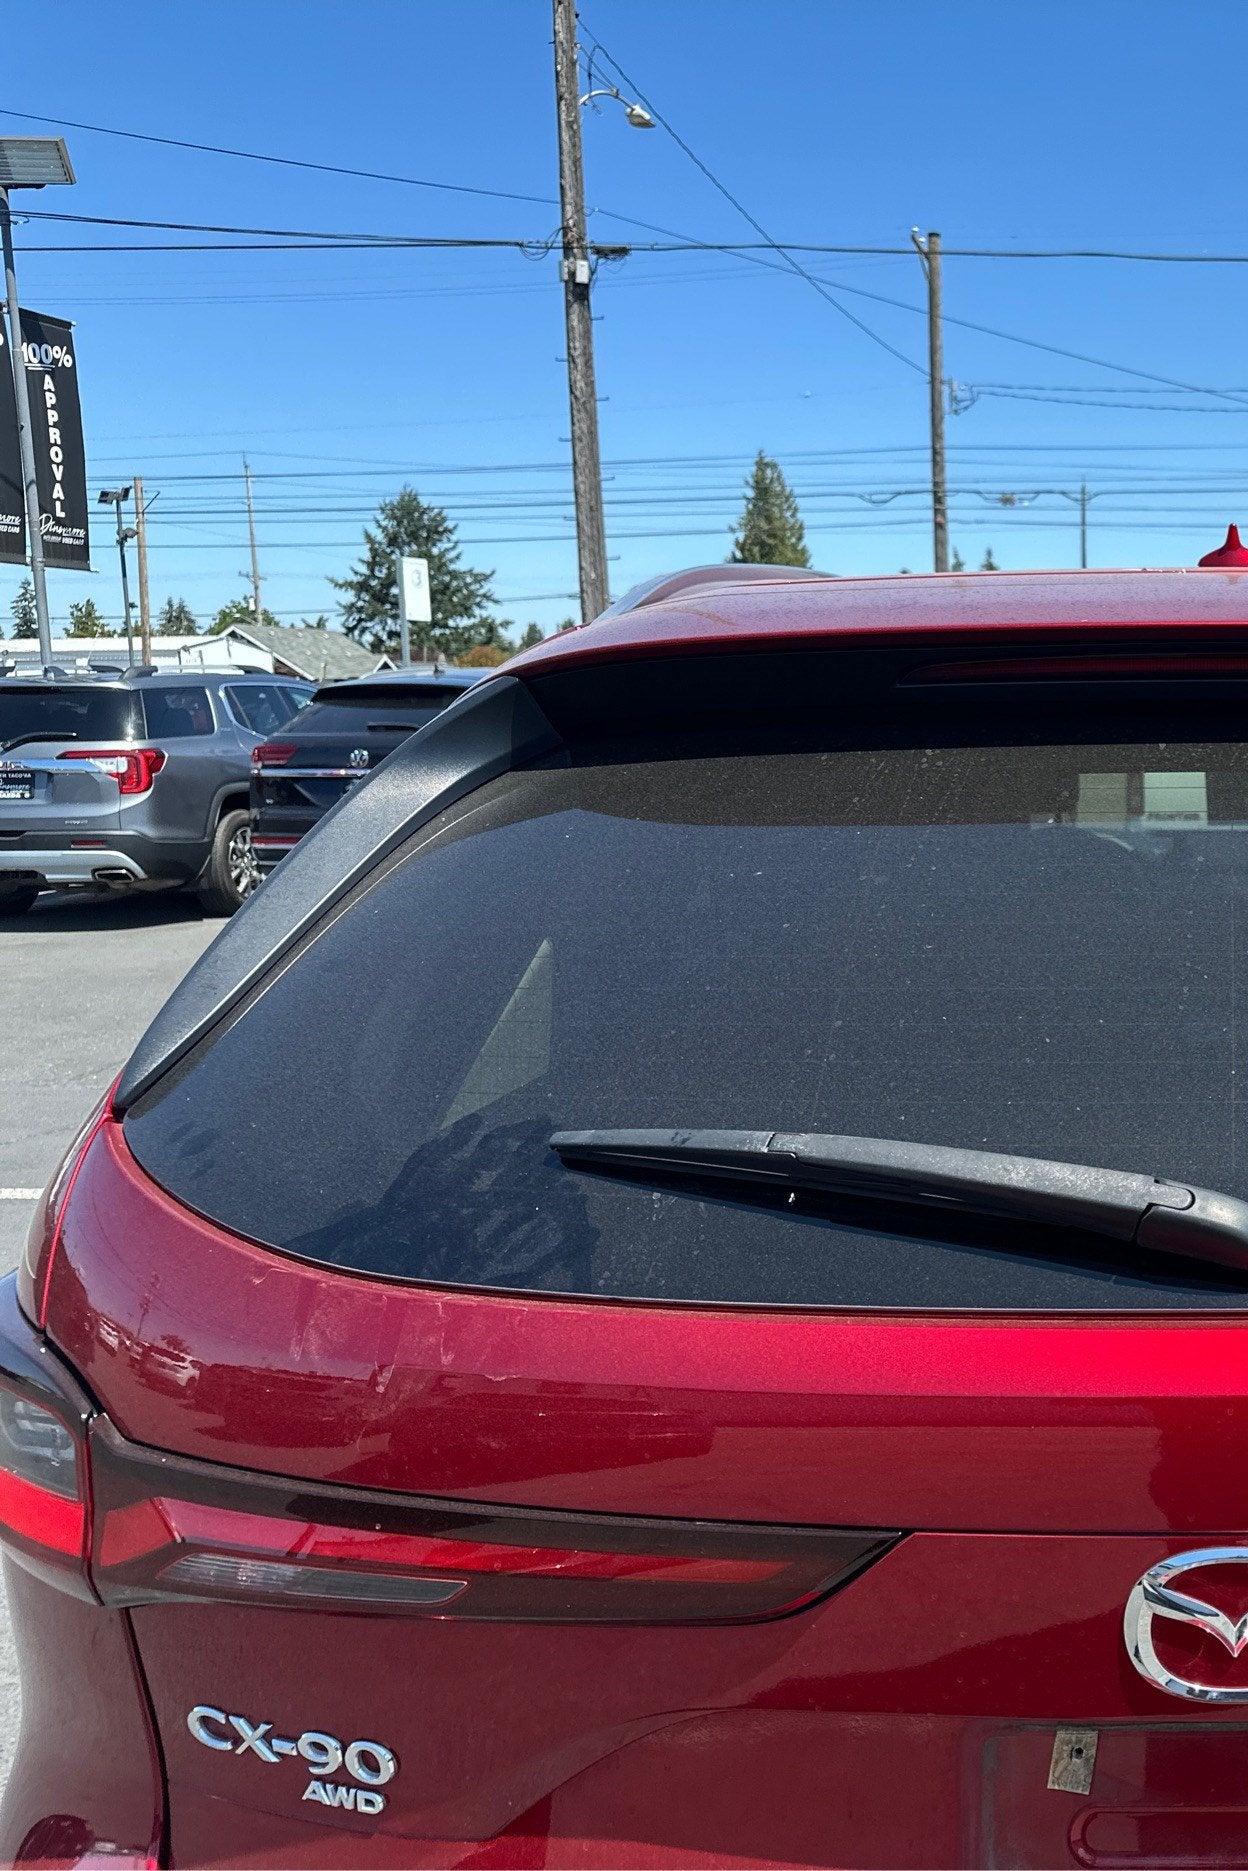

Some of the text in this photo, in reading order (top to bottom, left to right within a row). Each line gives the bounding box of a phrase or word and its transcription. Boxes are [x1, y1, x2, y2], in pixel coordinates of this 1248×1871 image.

[21, 342, 73, 368] 100%
[43, 374, 66, 518] APPROVAL
[187, 1705, 398, 1786] CX-90
[302, 1780, 387, 1815] AWD
